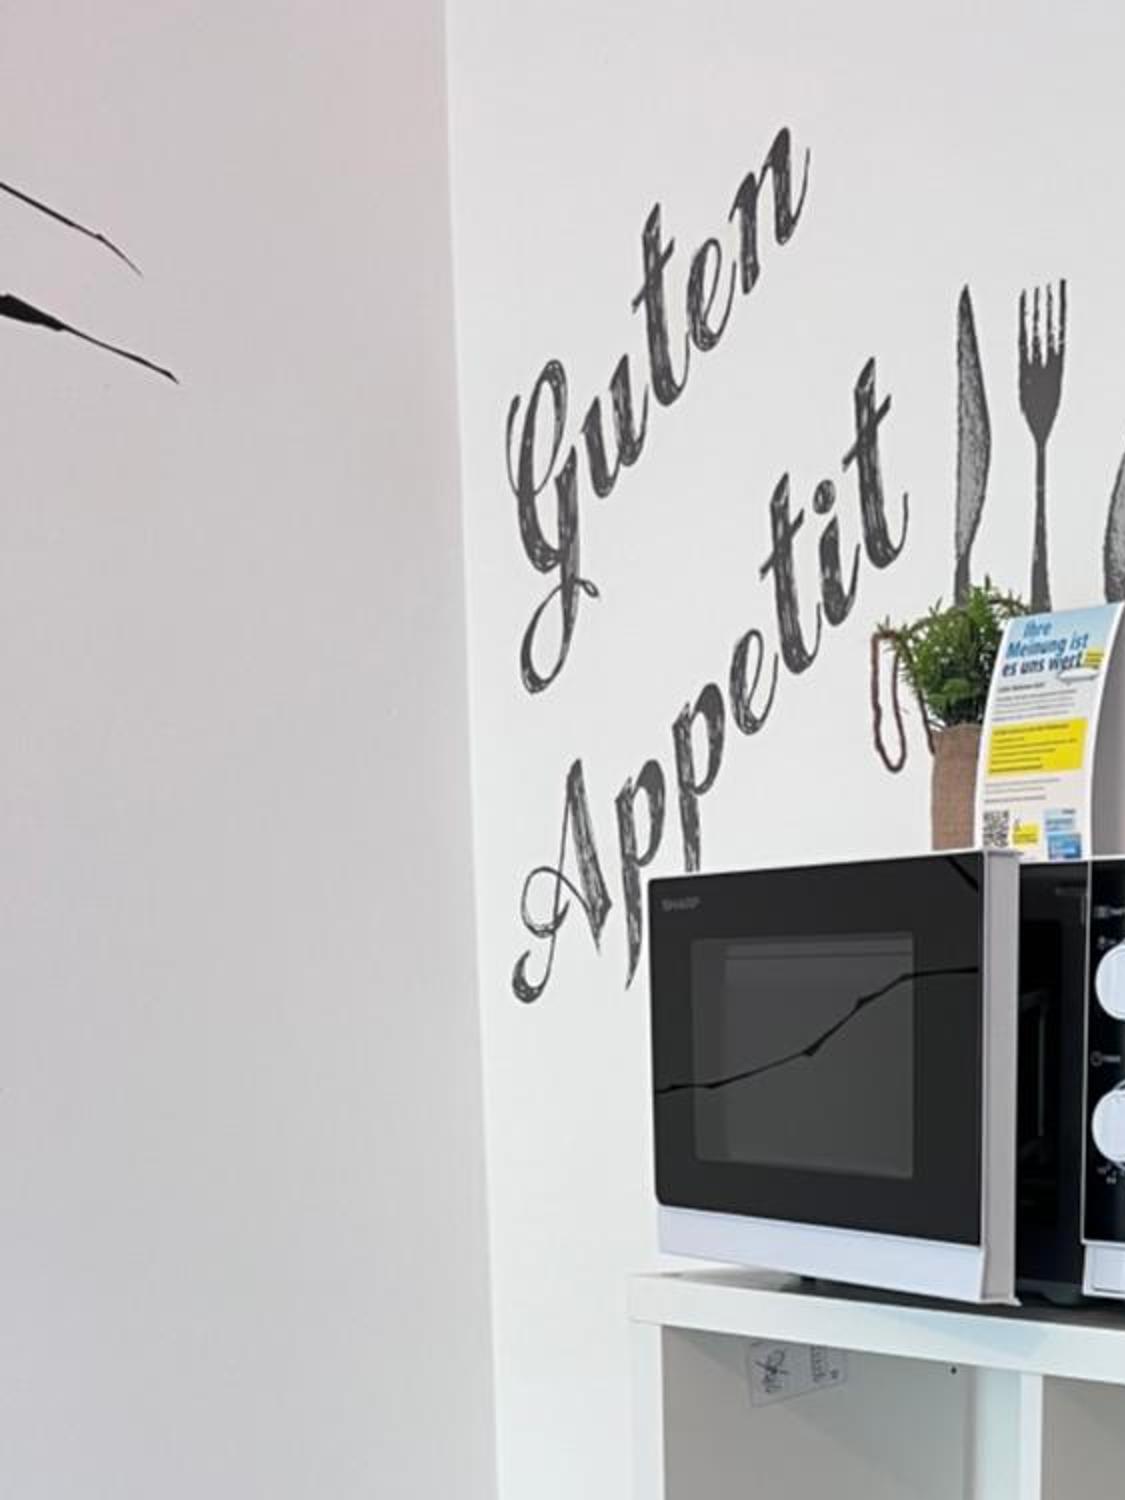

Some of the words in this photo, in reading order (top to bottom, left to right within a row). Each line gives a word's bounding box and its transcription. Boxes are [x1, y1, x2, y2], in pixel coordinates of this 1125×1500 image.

[505, 127, 810, 694] Guten
[1023, 619, 1052, 638] Ihre
[1006, 638, 1067, 658] Meinung
[1070, 631, 1089, 650] ist
[511, 356, 908, 1003] Appetit
[1002, 662, 1017, 678] es
[1020, 657, 1045, 674] uns
